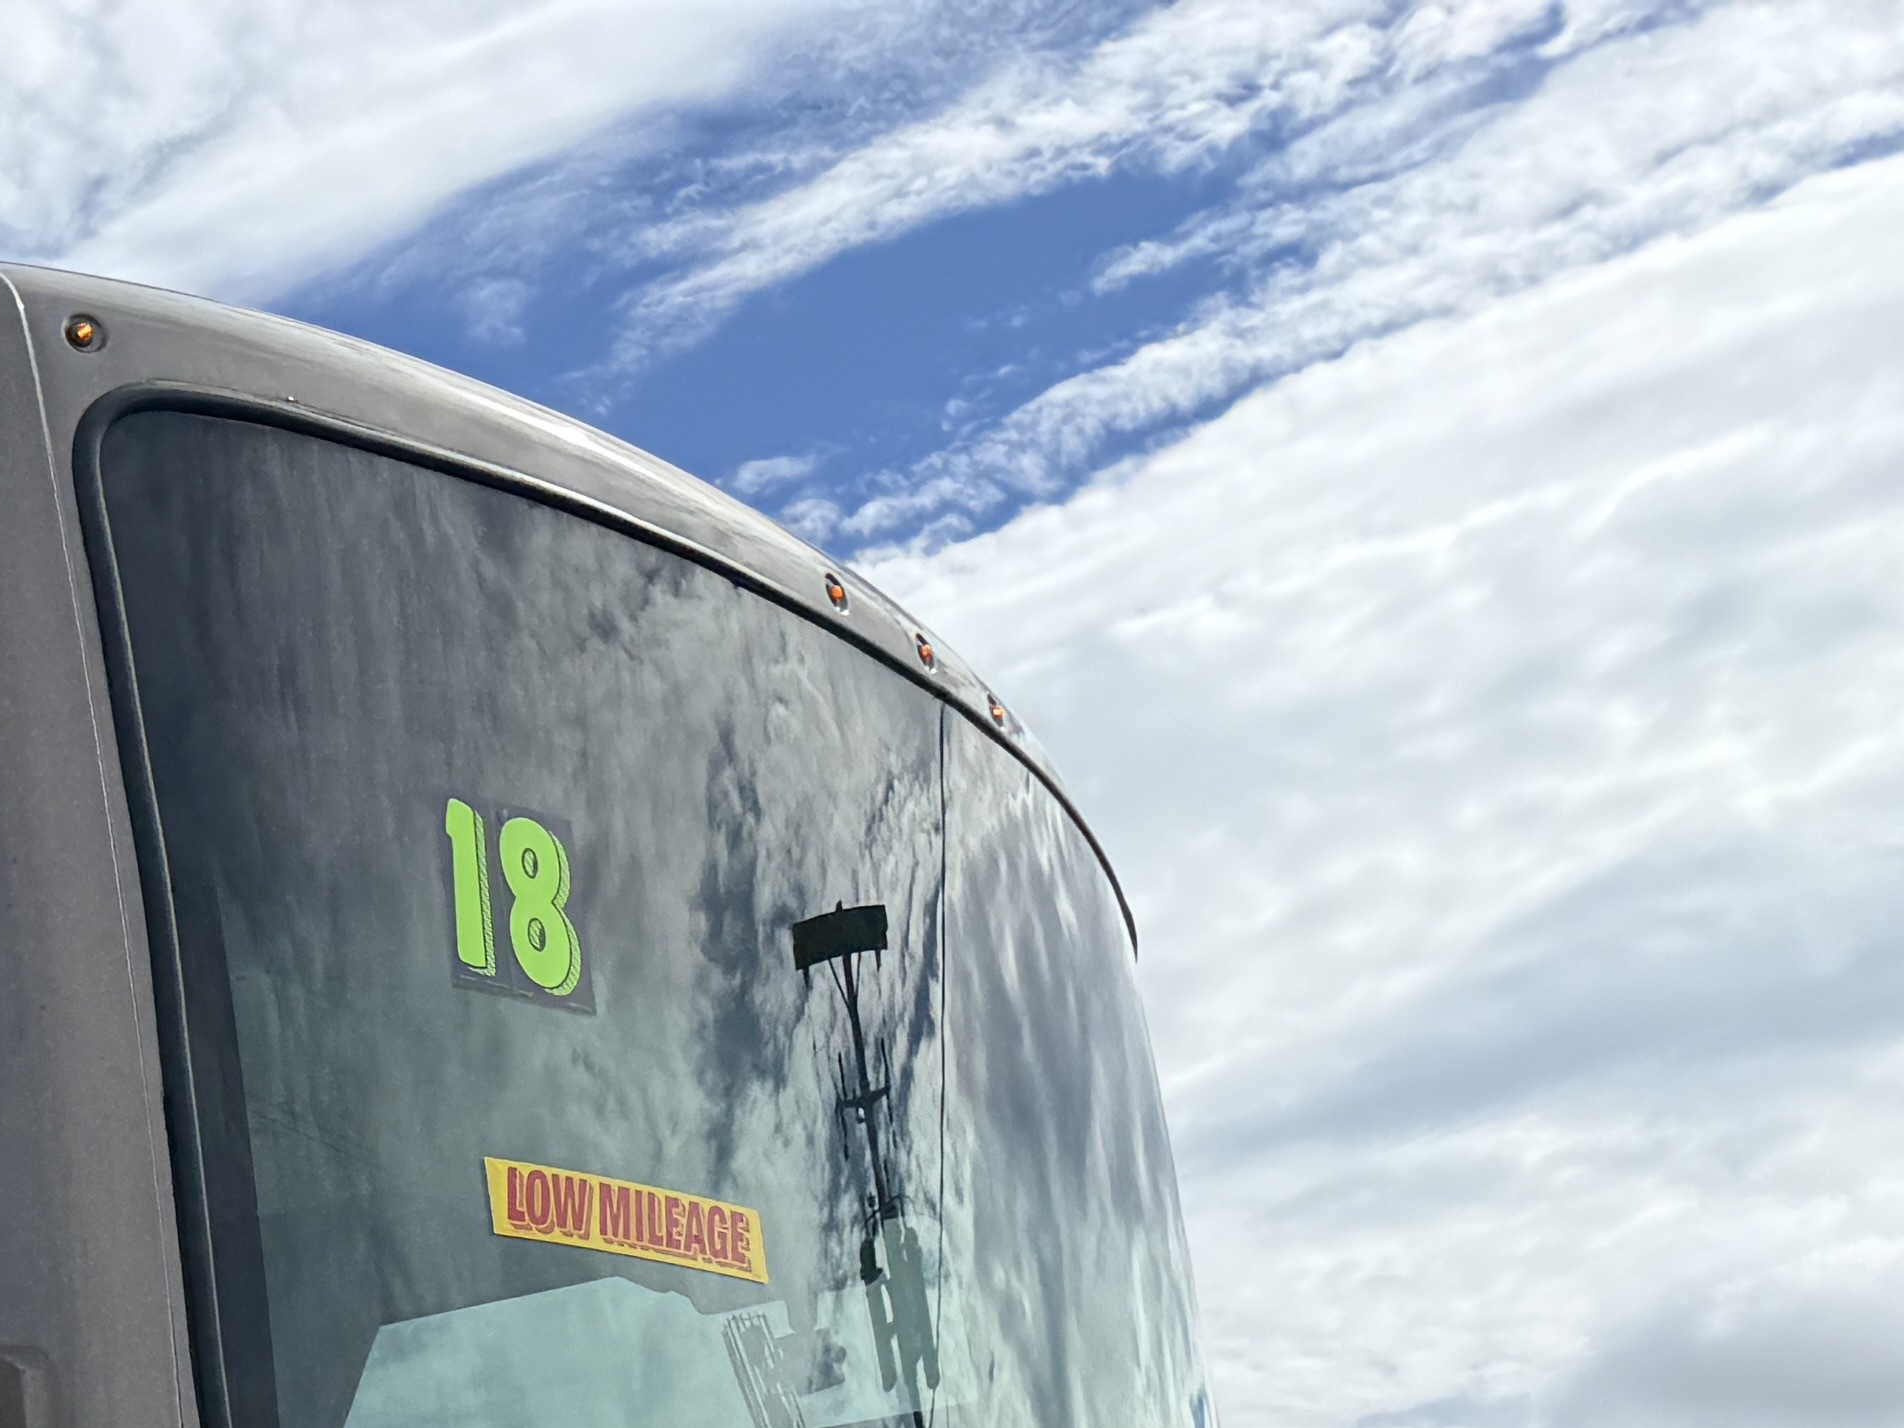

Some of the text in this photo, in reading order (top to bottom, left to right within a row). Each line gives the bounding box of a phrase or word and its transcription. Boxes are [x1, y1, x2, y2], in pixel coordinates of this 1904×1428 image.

[446, 798, 582, 996] 18
[507, 1166, 752, 1272] LOW MILEAGE
